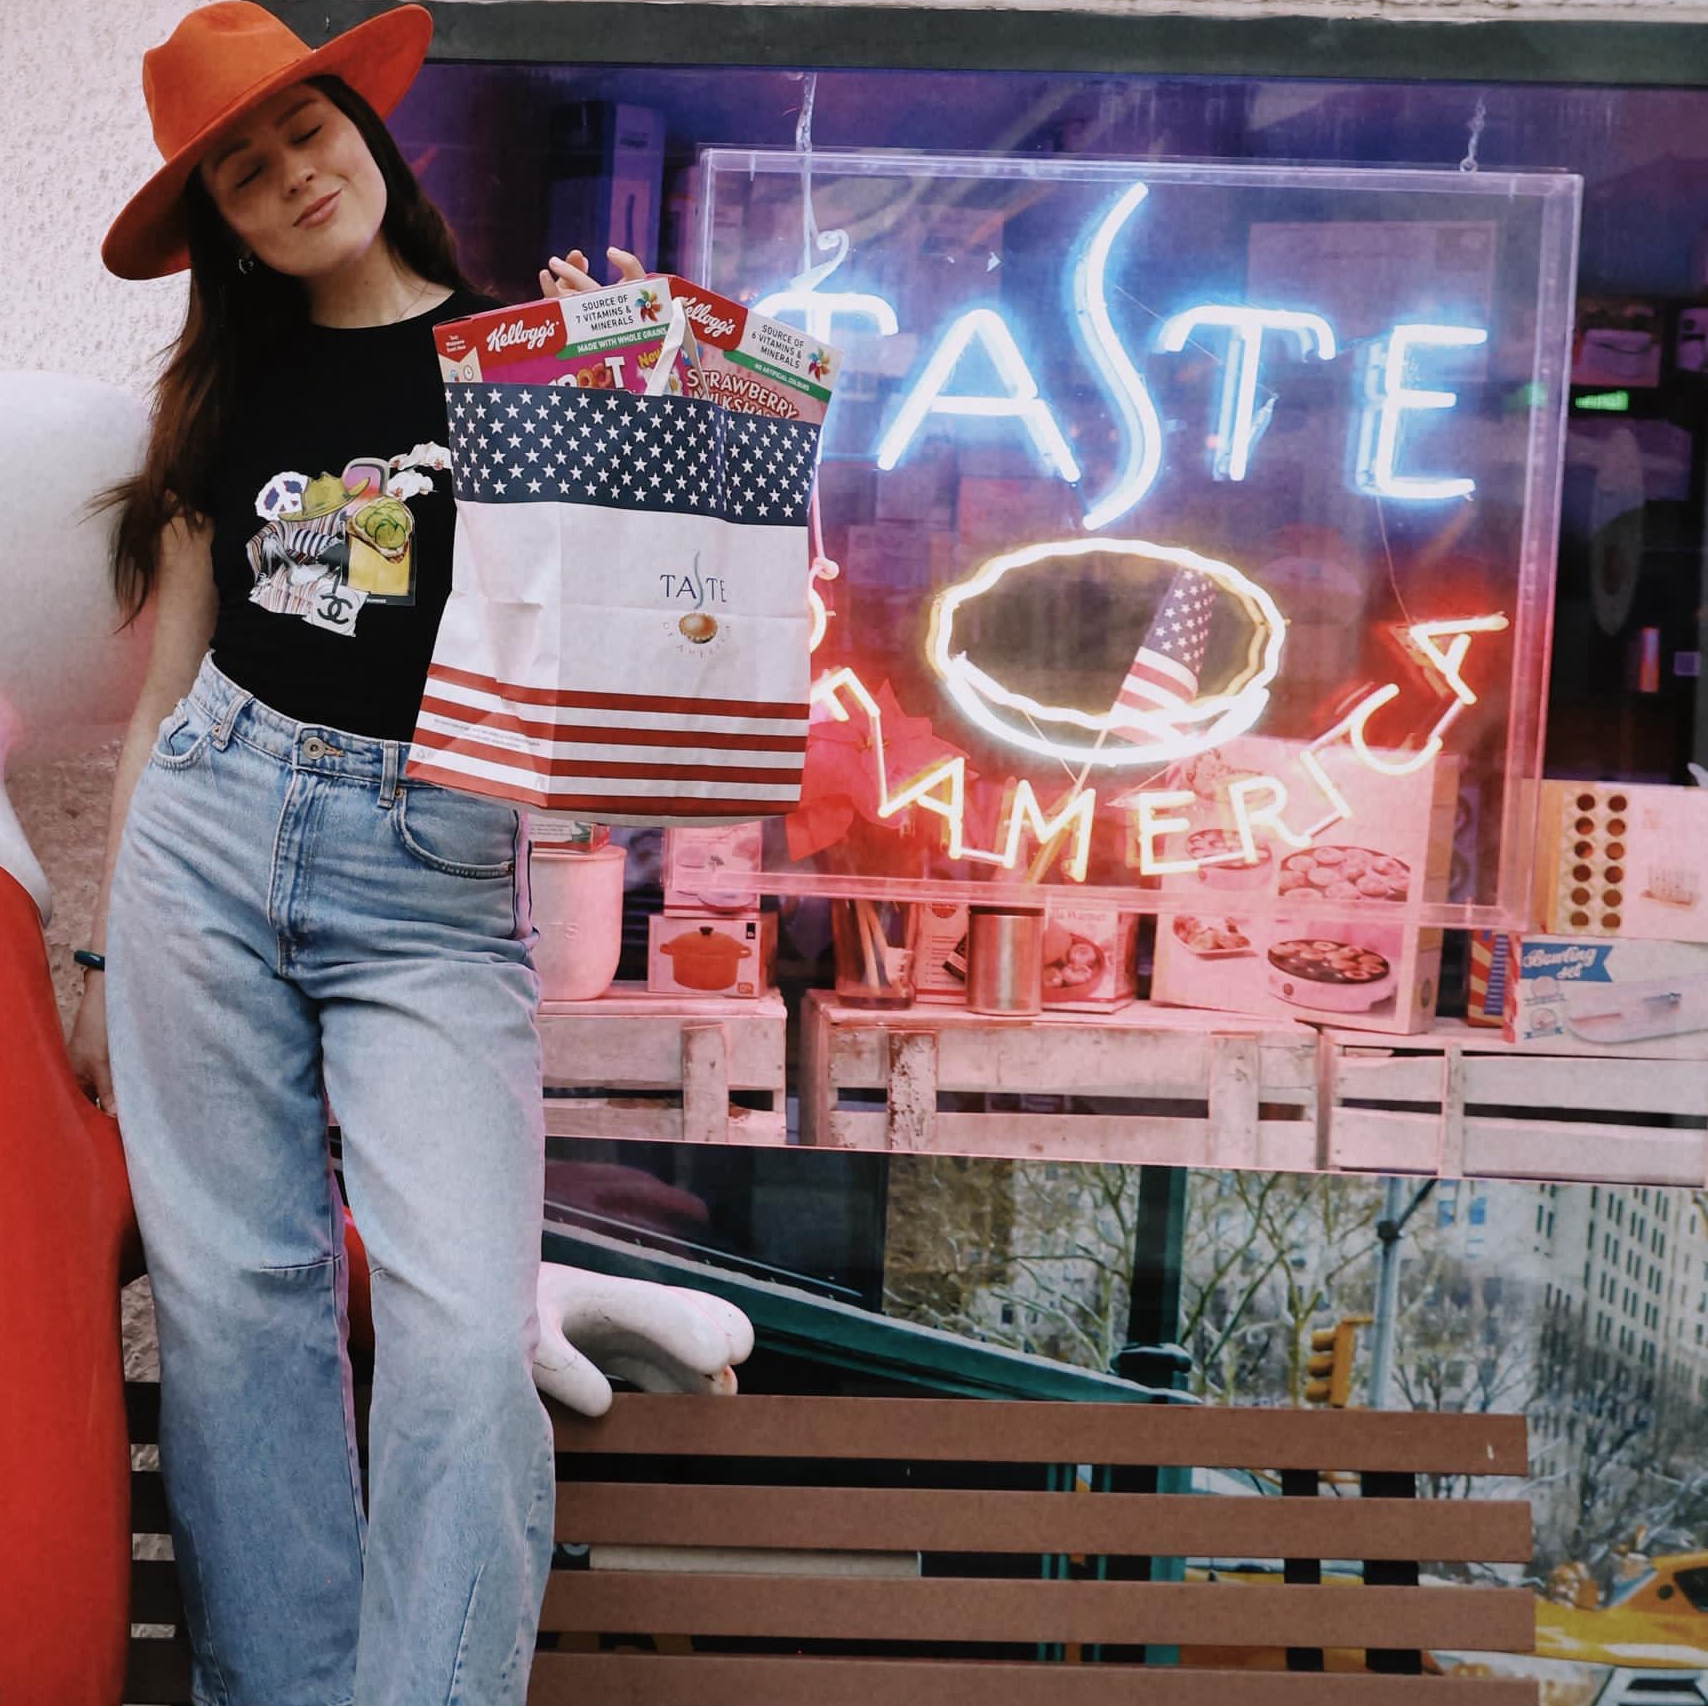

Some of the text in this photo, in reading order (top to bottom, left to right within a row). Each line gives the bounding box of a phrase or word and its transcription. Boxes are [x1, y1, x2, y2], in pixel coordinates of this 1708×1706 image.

[576, 306, 632, 324] 7 VITAMINS &
[582, 294, 629, 311] SOURCE OF
[486, 317, 556, 353] Kellogg's
[591, 316, 634, 331] MINERALS
[761, 324, 805, 348] SOURCE OF
[577, 340, 598, 353] MADE
[598, 337, 618, 349] WITH
[617, 333, 641, 346] WHOLE
[758, 333, 796, 355] VITAMINS
[796, 350, 802, 359] &
[752, 181, 1490, 531] TASTE
[760, 346, 800, 369] MINERALS
[687, 369, 798, 419] STRAWBERRY
[659, 550, 727, 610] TASTE
[877, 610, 1509, 884] AMERICA
